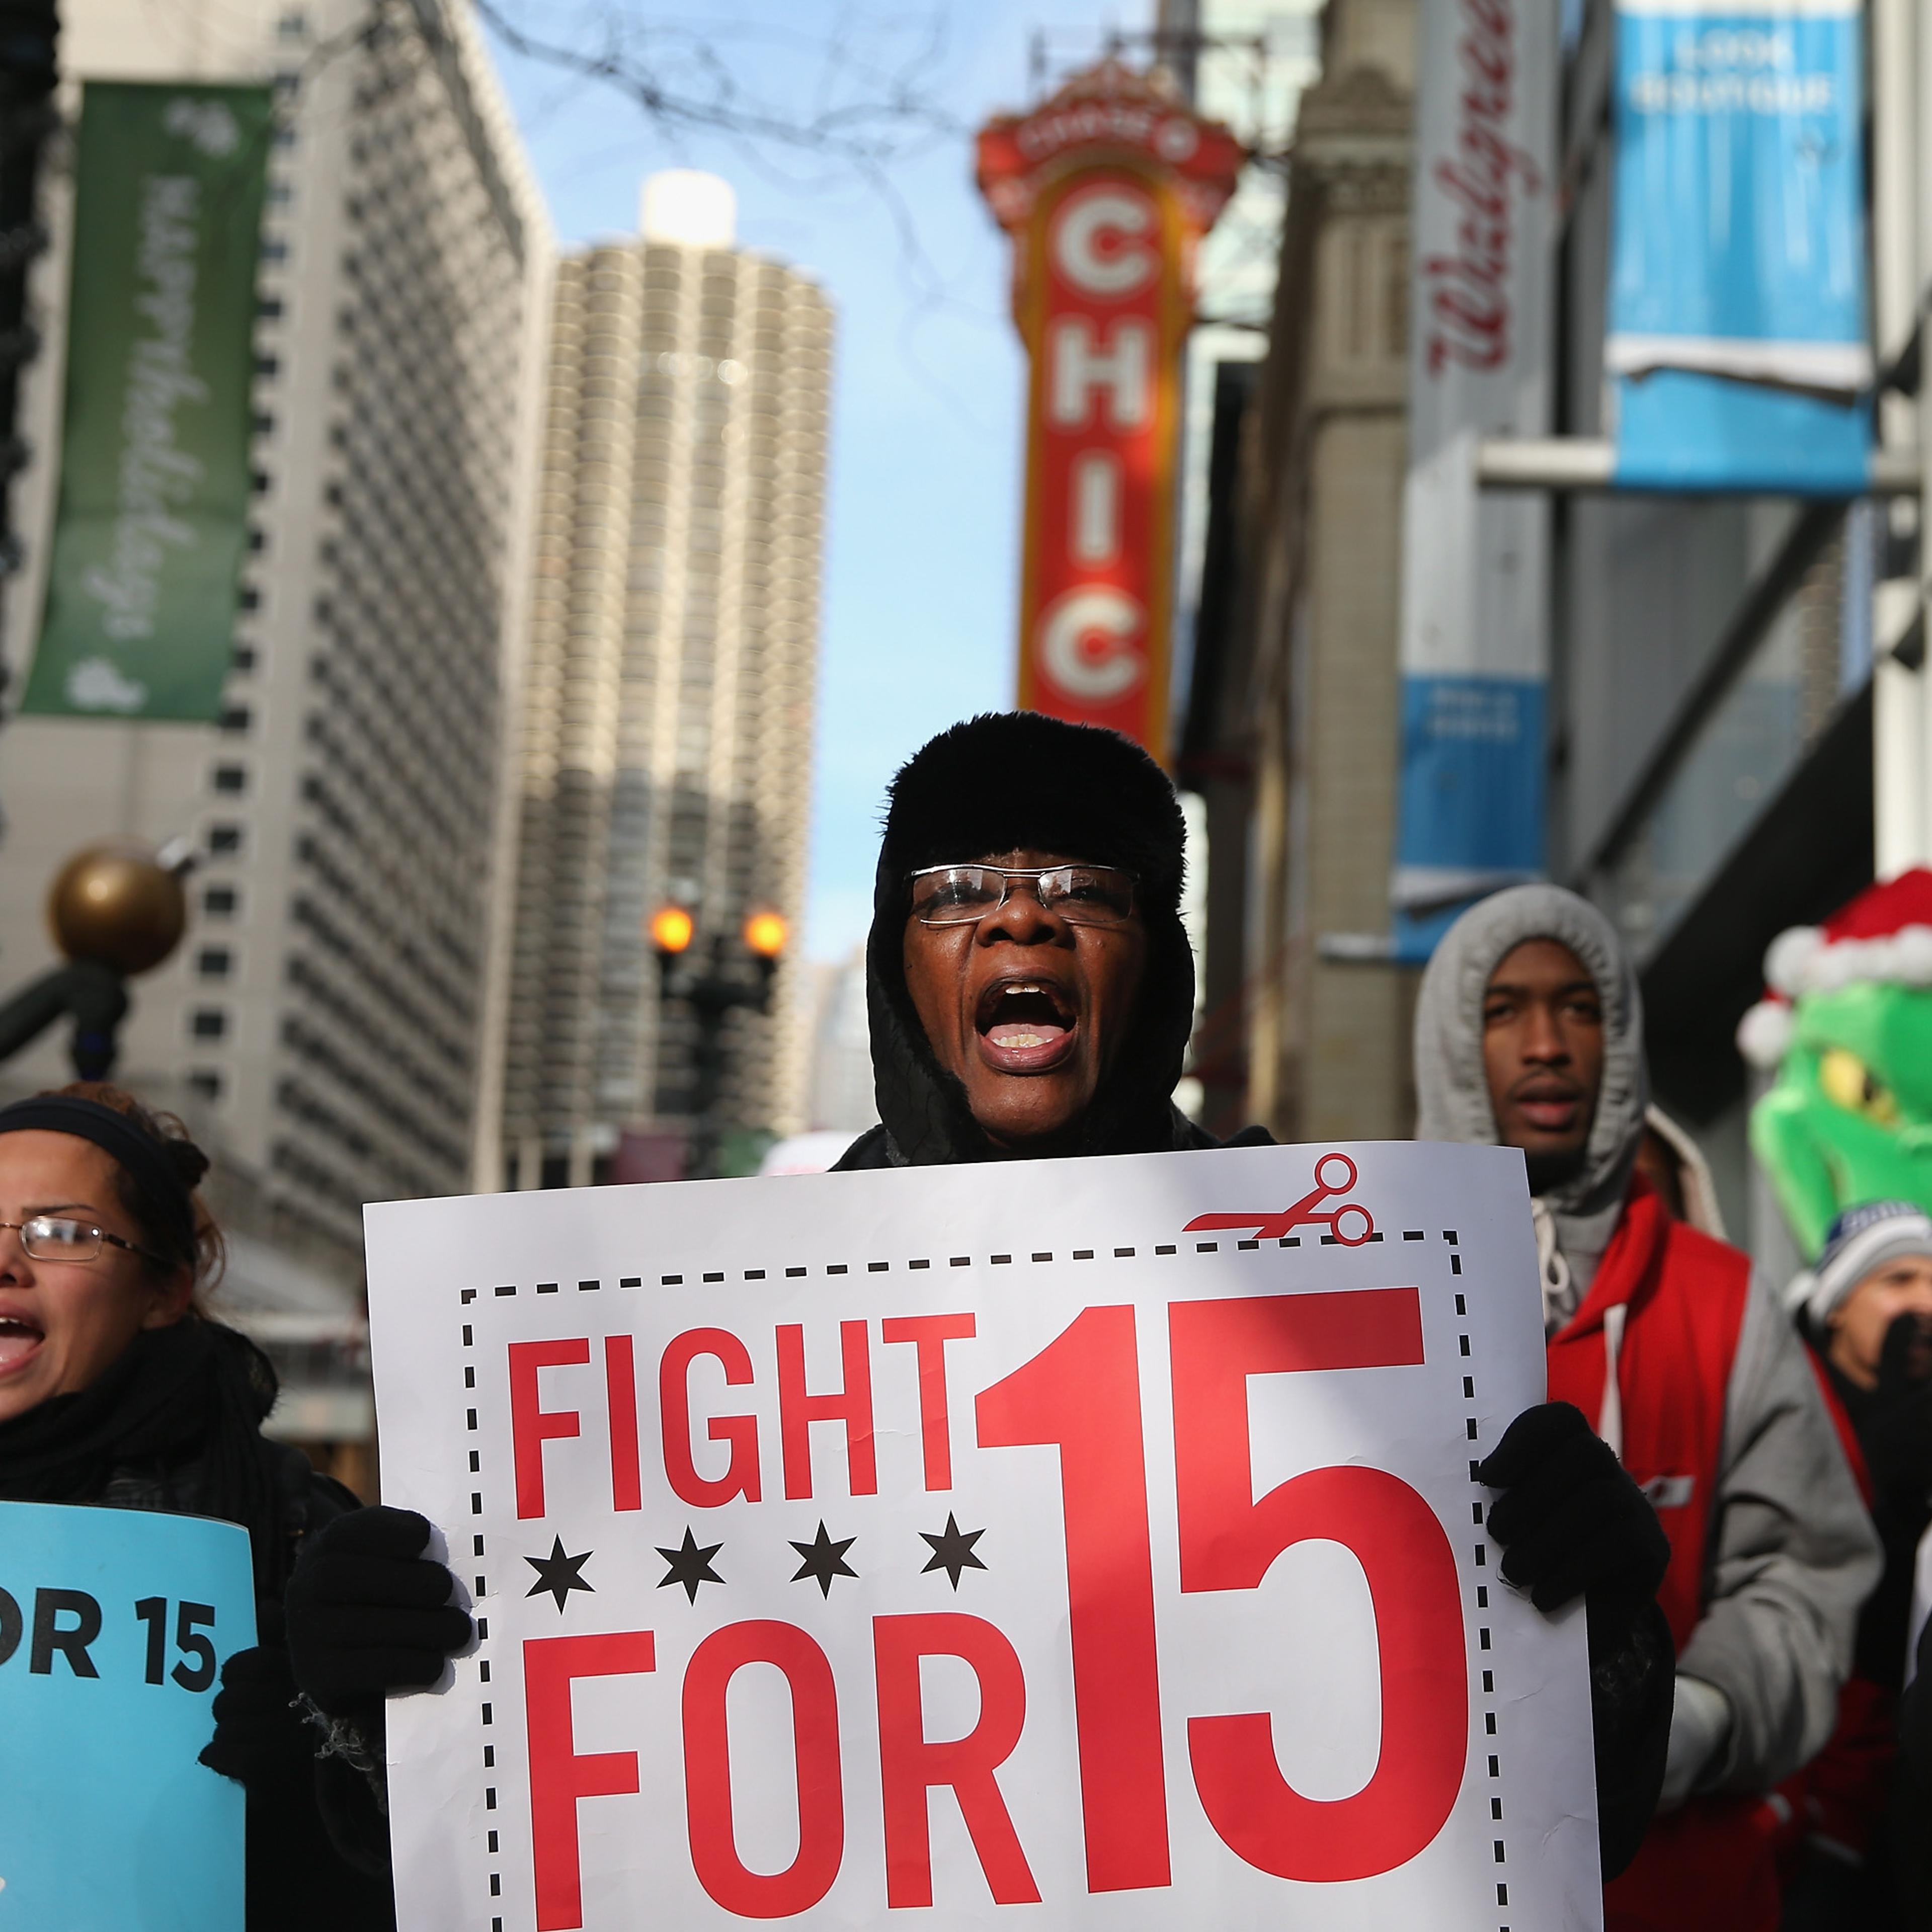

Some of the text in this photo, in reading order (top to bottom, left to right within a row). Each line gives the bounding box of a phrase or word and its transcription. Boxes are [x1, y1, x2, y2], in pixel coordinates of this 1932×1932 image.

[1673, 28, 1795, 71] LOOK
[1040, 193, 1154, 696] CHIC
[509, 1312, 977, 1520] FIGHT
[0, 1586, 216, 1693] R 15
[975, 1287, 1468, 1894] 15
[523, 1613, 1042, 1931] FOR
